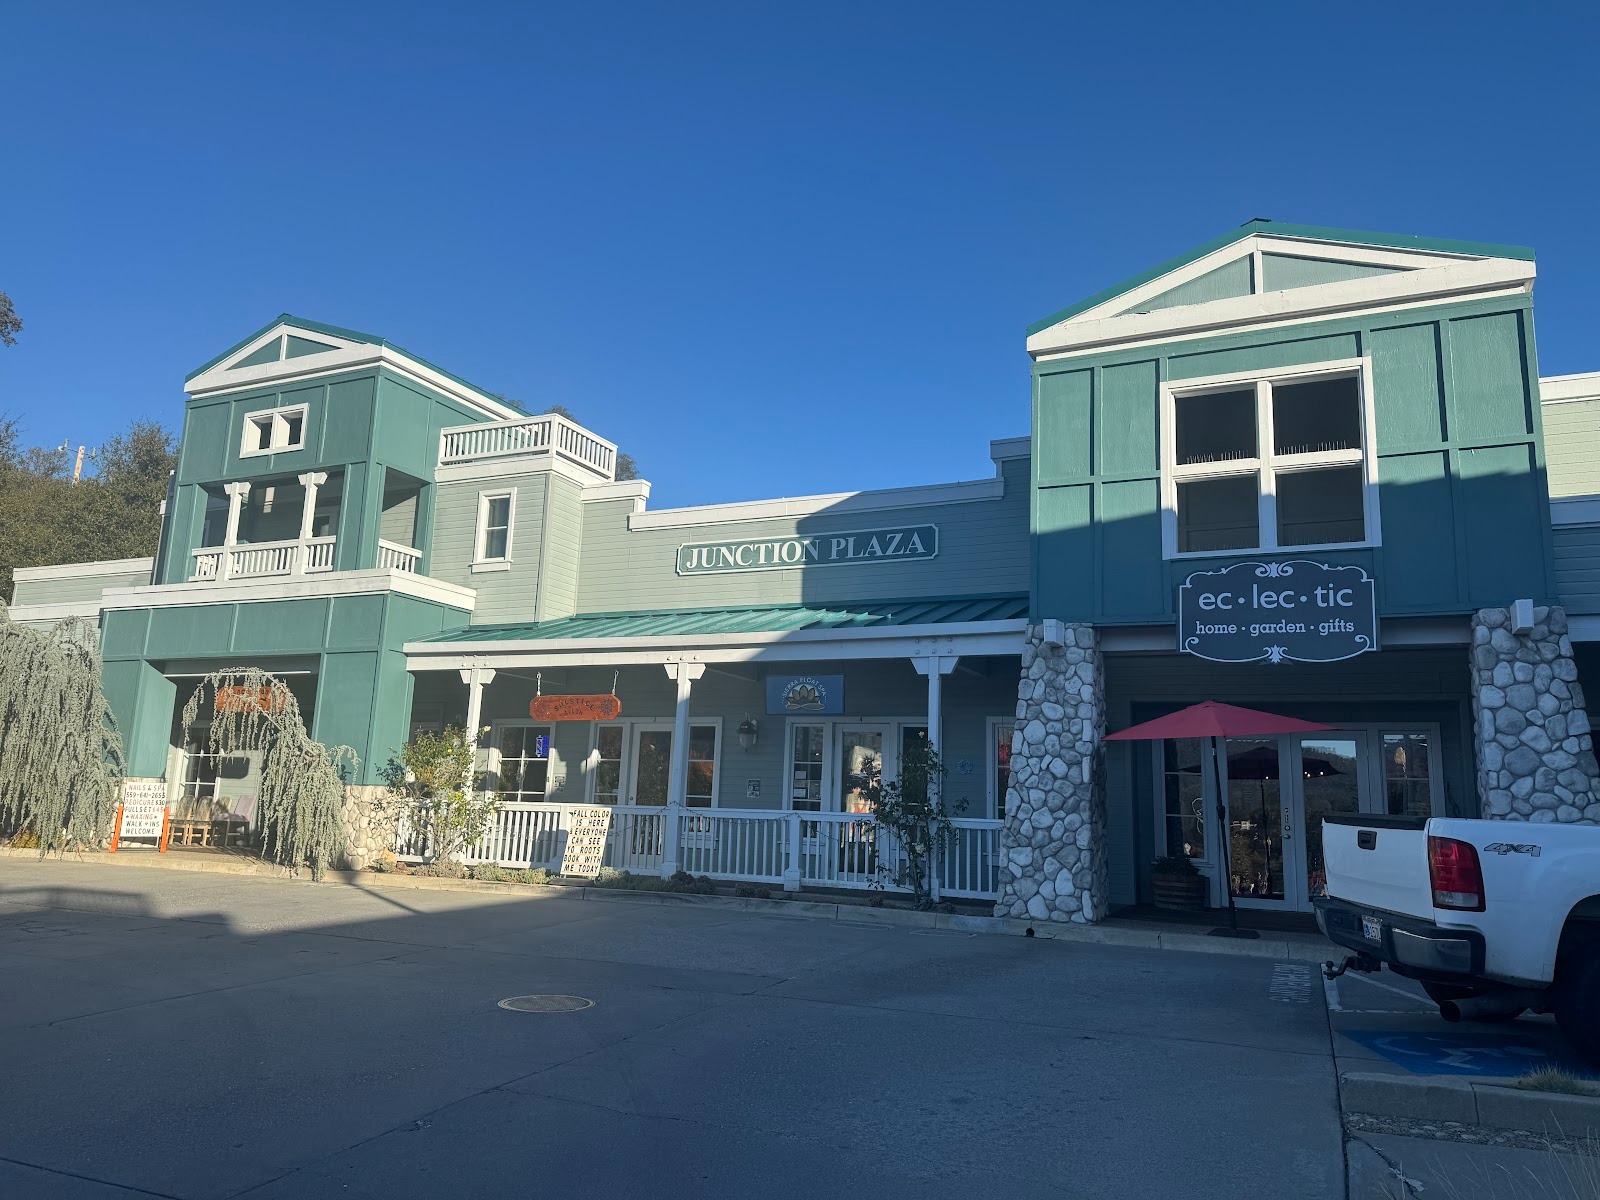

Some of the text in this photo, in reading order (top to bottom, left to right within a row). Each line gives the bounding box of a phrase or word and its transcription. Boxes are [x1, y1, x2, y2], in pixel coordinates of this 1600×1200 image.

[686, 531, 927, 569] JUNCTION PLAZA
[1195, 618, 1355, 637] home garden gifts
[782, 676, 827, 698] SIERRA FLOAT SPA
[554, 698, 596, 712] SOLSTICE
[589, 810, 610, 818] COLOR
[576, 819, 605, 827] IS HERE
[571, 836, 601, 845] CAN SEE
[567, 845, 601, 854] YO ROOTS
[563, 854, 602, 864] BOOK WITH
[564, 864, 599, 873] ME TODAY
